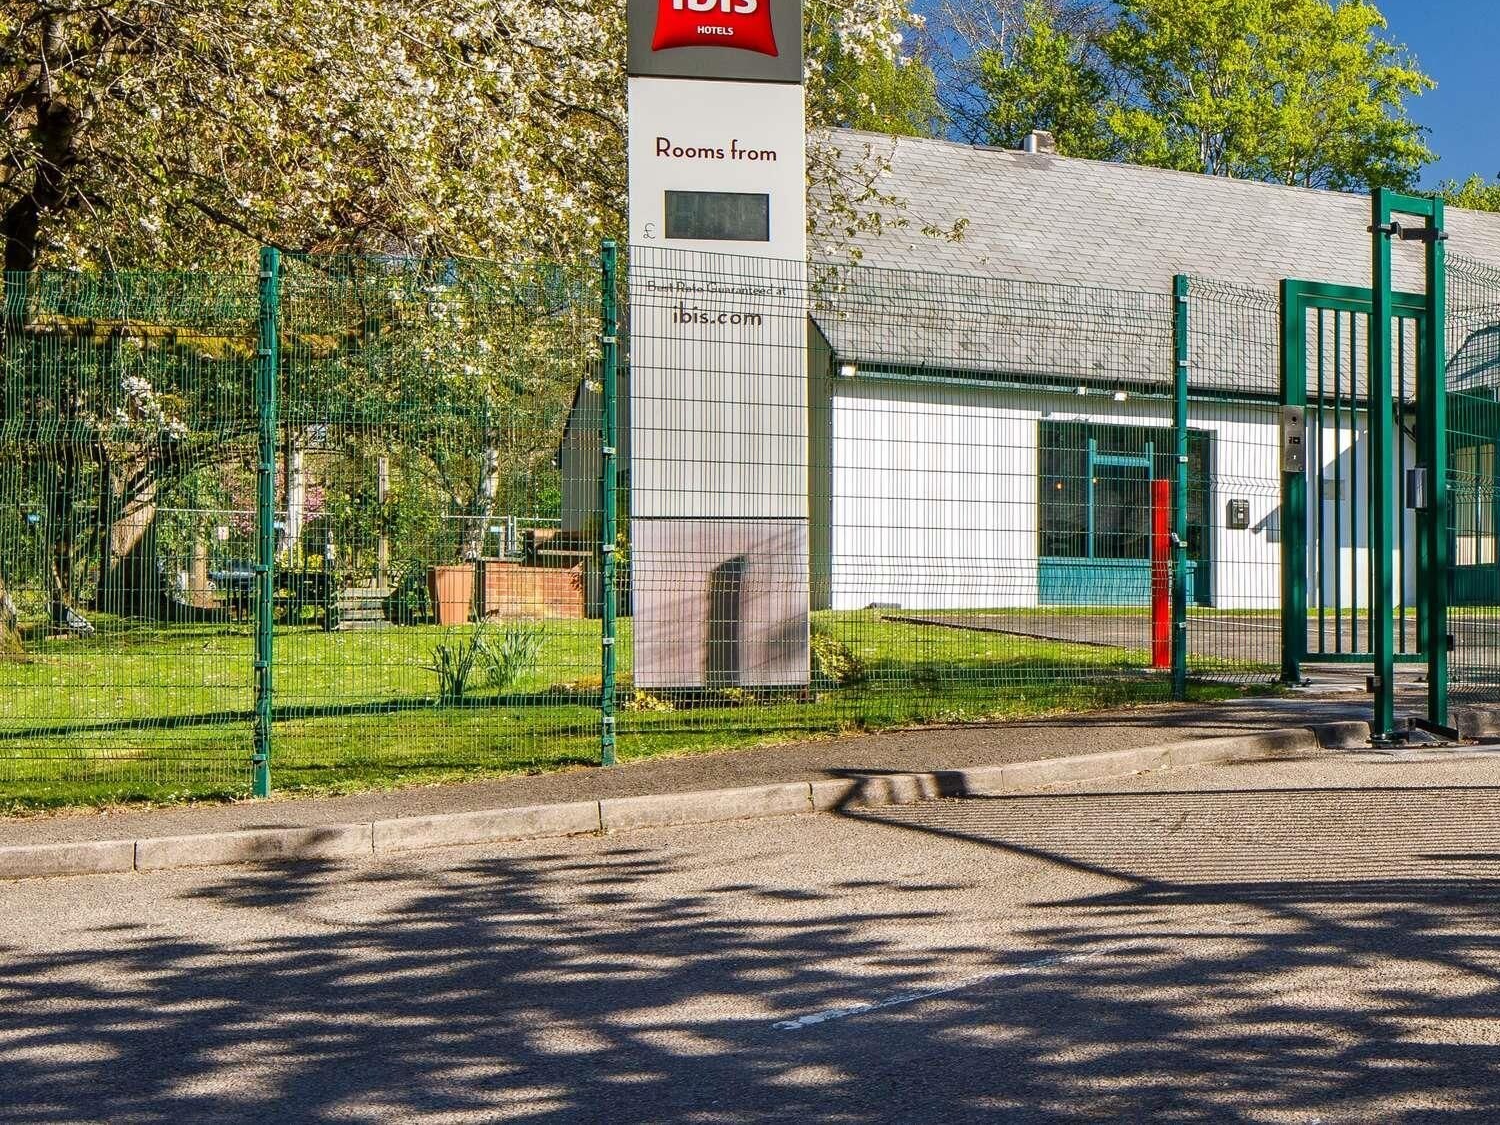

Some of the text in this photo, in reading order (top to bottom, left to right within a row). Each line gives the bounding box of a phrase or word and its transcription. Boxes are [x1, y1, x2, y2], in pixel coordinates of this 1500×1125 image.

[697, 25, 734, 36] HOTELS
[656, 136, 777, 161] Rooms from
[642, 222, 656, 240] £
[647, 280, 786, 296] Best Rate Guaranteed at
[673, 300, 762, 325] ibis.com
